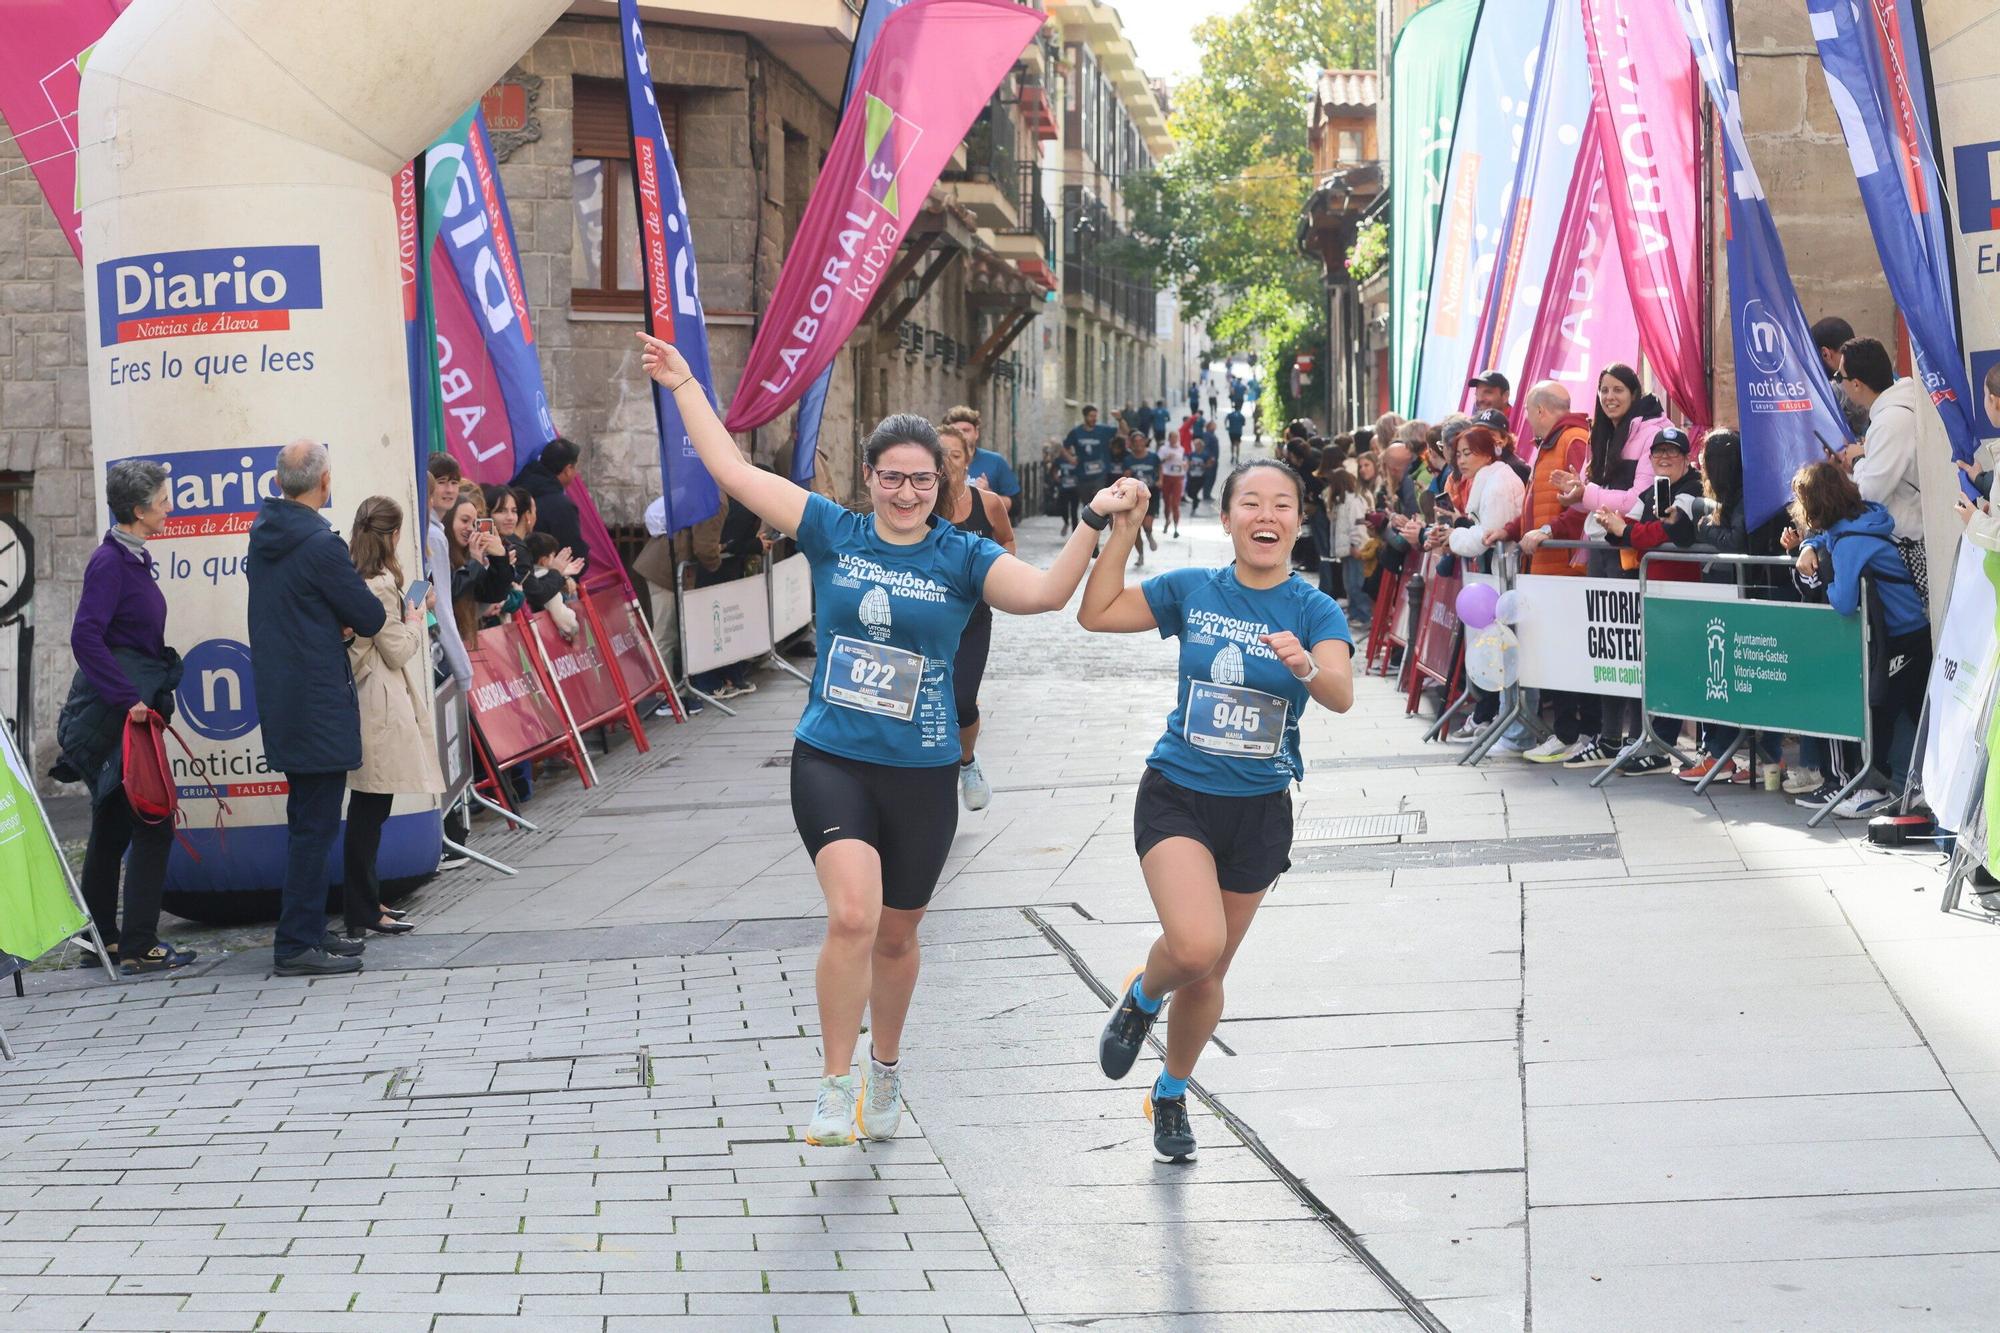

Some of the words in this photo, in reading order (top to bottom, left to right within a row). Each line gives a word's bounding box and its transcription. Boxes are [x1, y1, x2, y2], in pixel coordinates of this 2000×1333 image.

[640, 144, 658, 208] Álava
[646, 213, 661, 235] de
[845, 221, 900, 303] kutxa
[115, 255, 288, 315] Diario
[650, 241, 670, 322] Noticias
[759, 208, 879, 395] LABORAL
[136, 319, 189, 338] Noticias
[191, 317, 208, 333] de
[211, 312, 260, 332] Álava
[110, 356, 151, 386] Eres
[161, 351, 183, 379] lo
[194, 351, 248, 384] que
[260, 344, 315, 372] lees
[1748, 377, 1806, 398] noticias
[162, 456, 286, 510] iario
[160, 520, 197, 537] ticias
[200, 518, 217, 533] de
[220, 513, 254, 533] Ála
[170, 551, 191, 580] lo
[839, 553, 850, 565] LA
[847, 567, 936, 592] ALMENDRA
[891, 586, 947, 603] KONKISTA
[1190, 608, 1201, 619] LA
[1203, 611, 1269, 635] CONQUISTA
[1733, 632, 1778, 648] Ayuntamiento
[1734, 649, 1742, 660] de
[1743, 650, 1789, 664] Vitoria-Gasteiz
[850, 658, 896, 691] 822
[1593, 665, 1617, 684] green
[1619, 665, 1643, 685] capit
[1733, 665, 1787, 683] Vitoria-Gasteizko
[1734, 680, 1752, 694] Udala
[202, 667, 243, 713] n
[1212, 702, 1260, 733] 945
[173, 748, 271, 778] noticia
[182, 786, 218, 797] GRUPO
[236, 783, 282, 795] TALDEA
